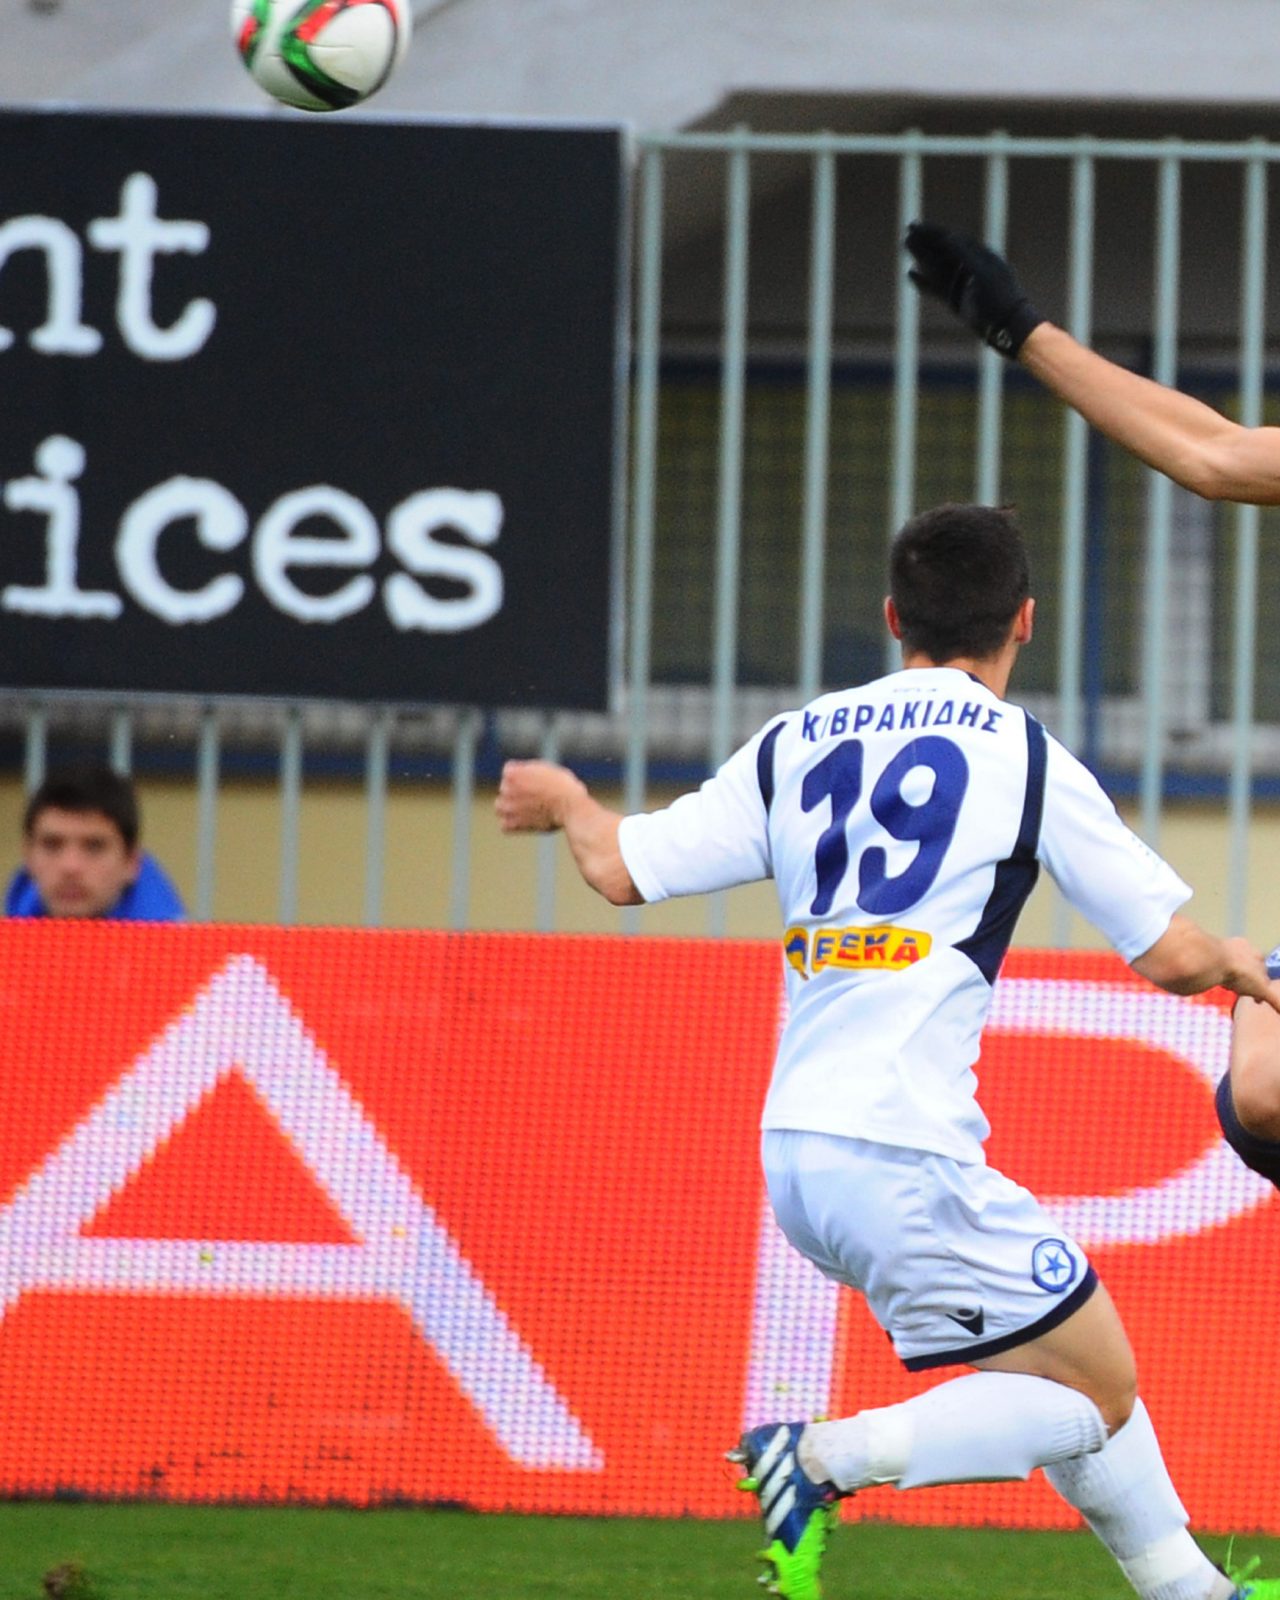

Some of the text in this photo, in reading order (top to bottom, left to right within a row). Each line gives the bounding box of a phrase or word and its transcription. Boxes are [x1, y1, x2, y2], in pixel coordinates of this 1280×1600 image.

[0, 171, 216, 361] nt
[2, 434, 504, 634] ices
[800, 735, 969, 916] 19
